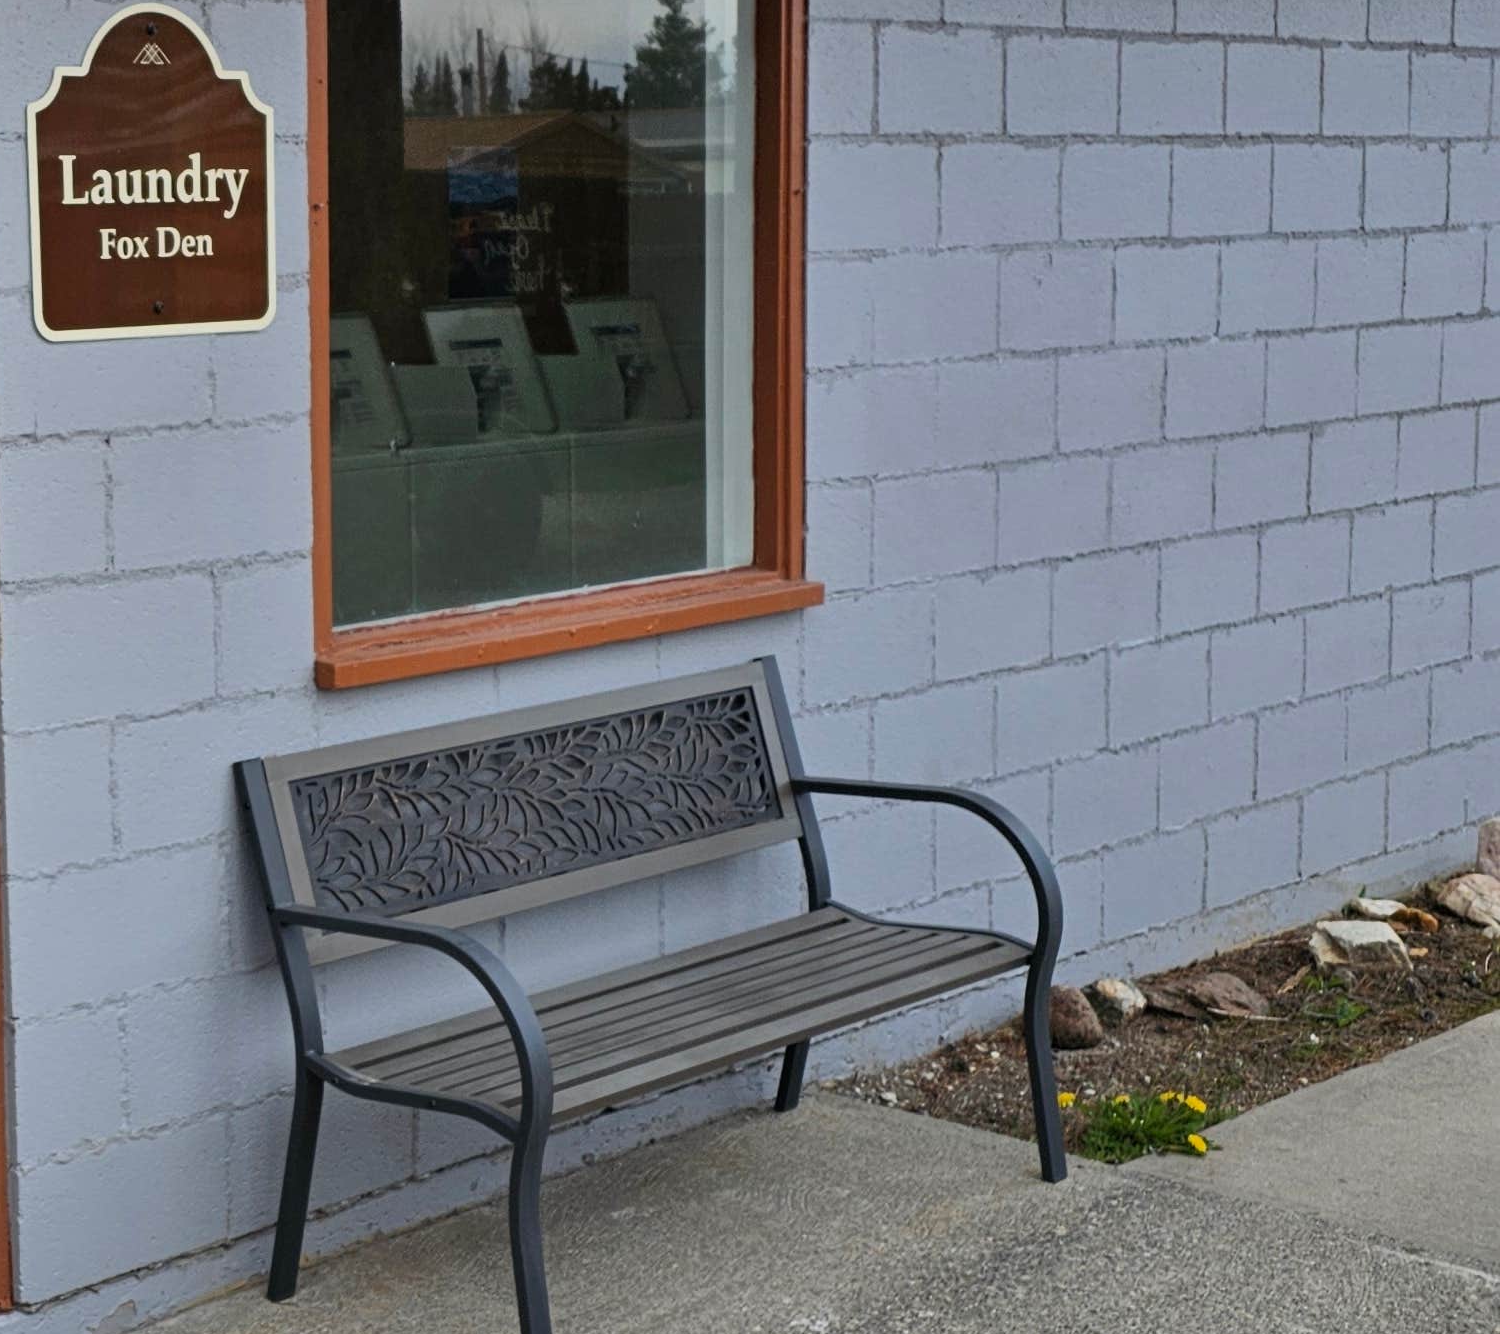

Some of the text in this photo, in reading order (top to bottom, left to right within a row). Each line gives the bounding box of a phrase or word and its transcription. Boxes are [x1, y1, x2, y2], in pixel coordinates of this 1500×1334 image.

[58, 152, 249, 220] Laundry
[100, 226, 214, 260] Fox Den
